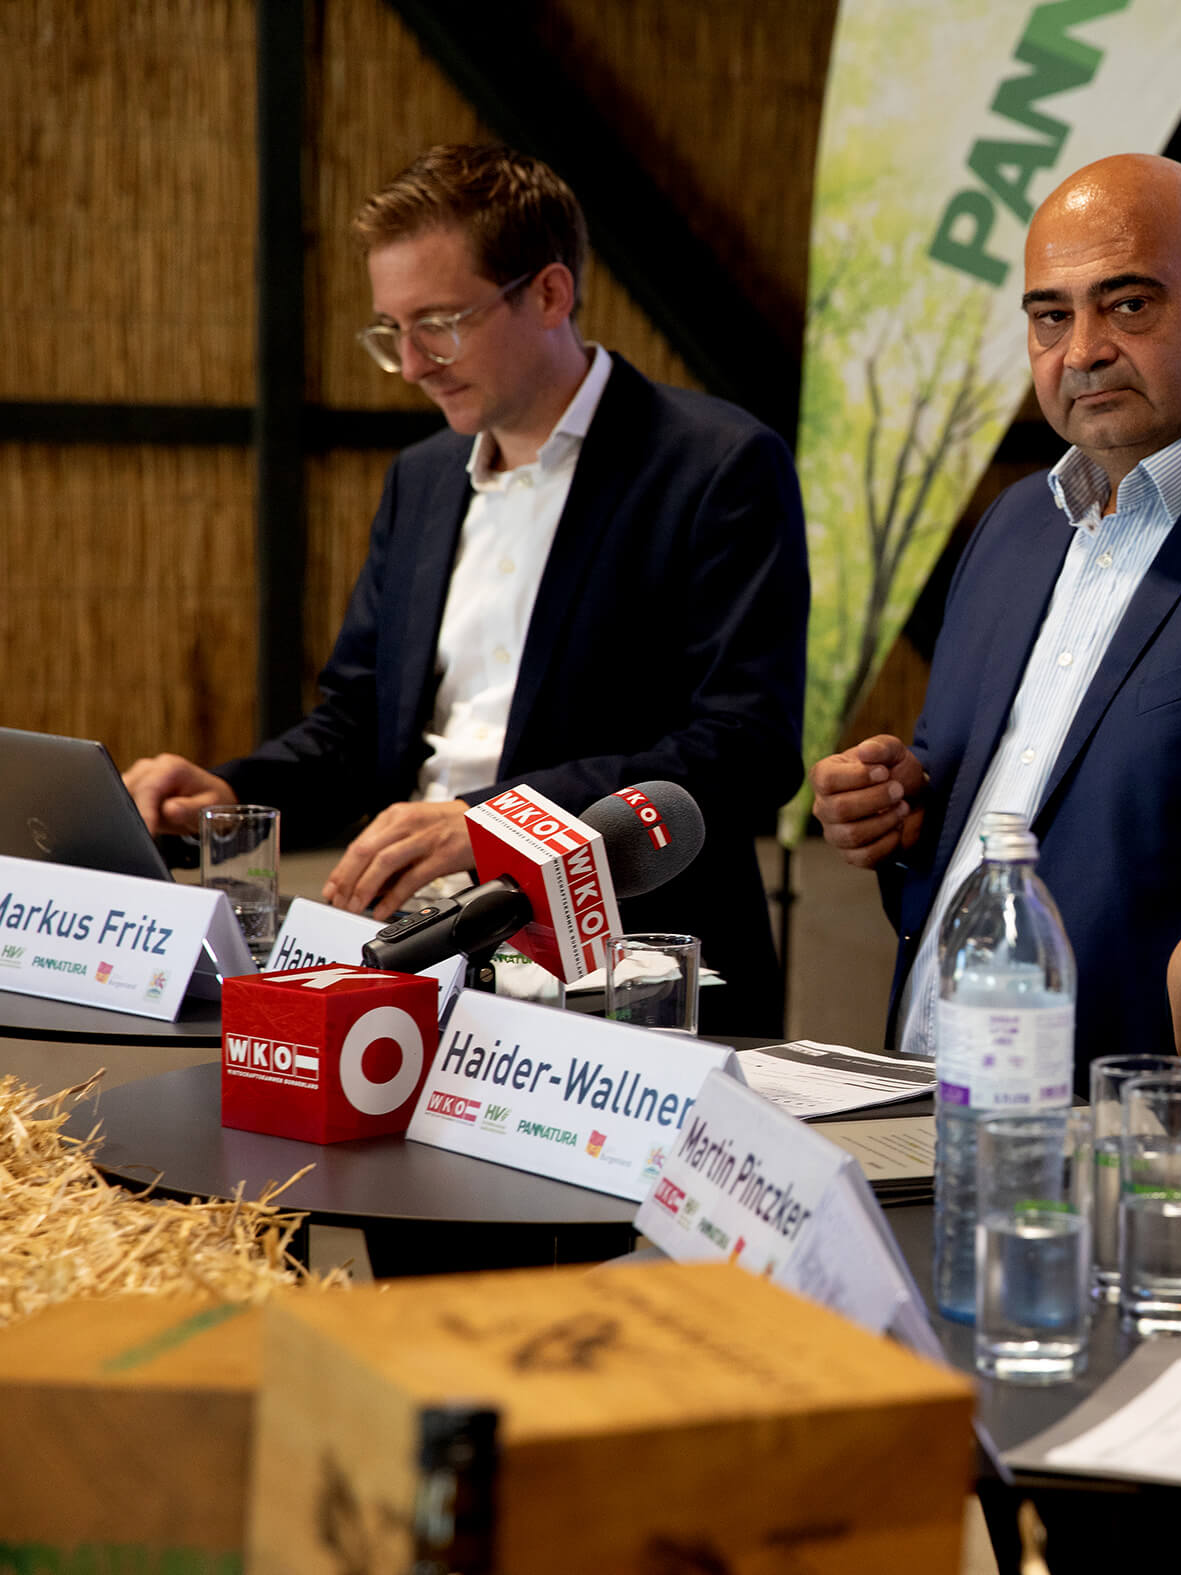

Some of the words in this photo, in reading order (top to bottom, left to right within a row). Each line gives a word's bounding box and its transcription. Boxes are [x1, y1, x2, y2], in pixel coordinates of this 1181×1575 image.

[492, 792, 560, 836] WKO
[567, 846, 604, 935] WKO
[98, 909, 174, 956] Fritz
[274, 935, 336, 970] Hann
[32, 956, 88, 976] PANNATURA
[227, 1037, 292, 1071] WKO
[441, 1030, 697, 1130] Haider-Wallner
[430, 1093, 466, 1115] WKO
[517, 1119, 578, 1147] PANNATURA
[678, 1116, 736, 1189] Martin
[728, 1152, 811, 1242] Pinczker
